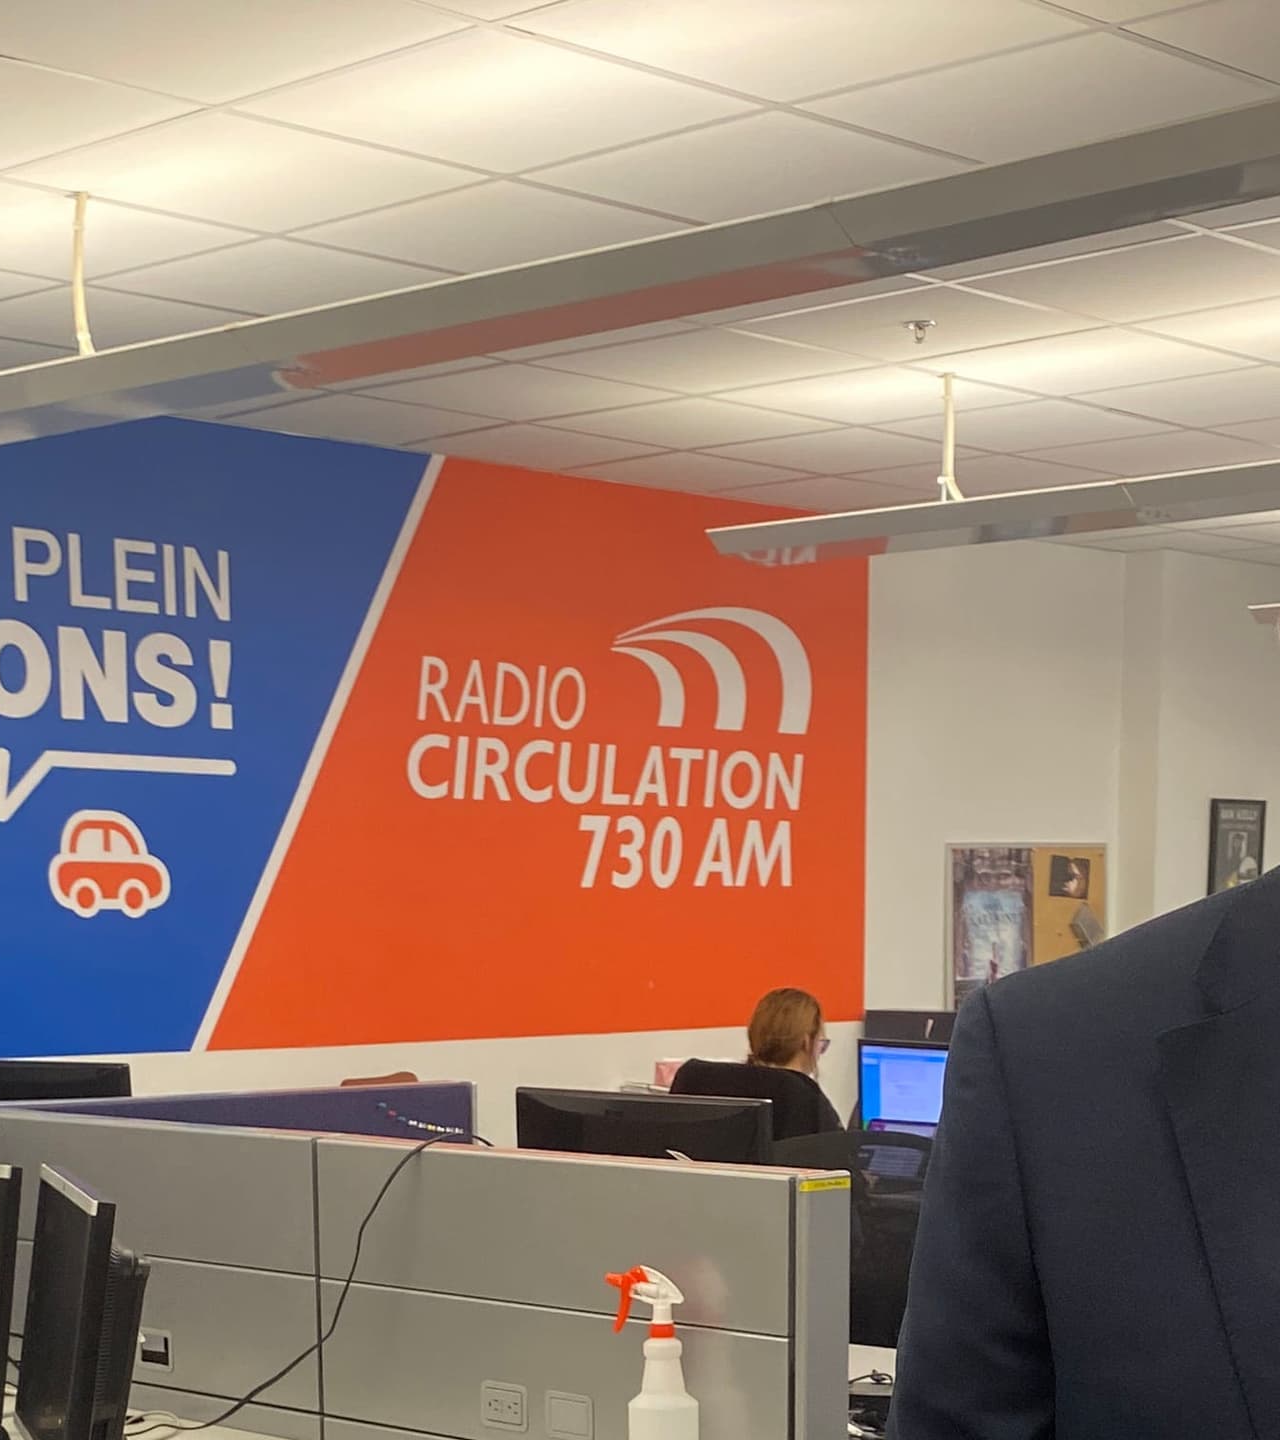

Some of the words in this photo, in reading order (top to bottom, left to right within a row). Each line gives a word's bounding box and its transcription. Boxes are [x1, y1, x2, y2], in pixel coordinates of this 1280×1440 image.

[11, 525, 232, 622] PLEIN
[417, 655, 587, 731] RADIO
[407, 733, 805, 812] CIRCULATION
[578, 813, 684, 889] 730
[692, 817, 793, 888] AM
